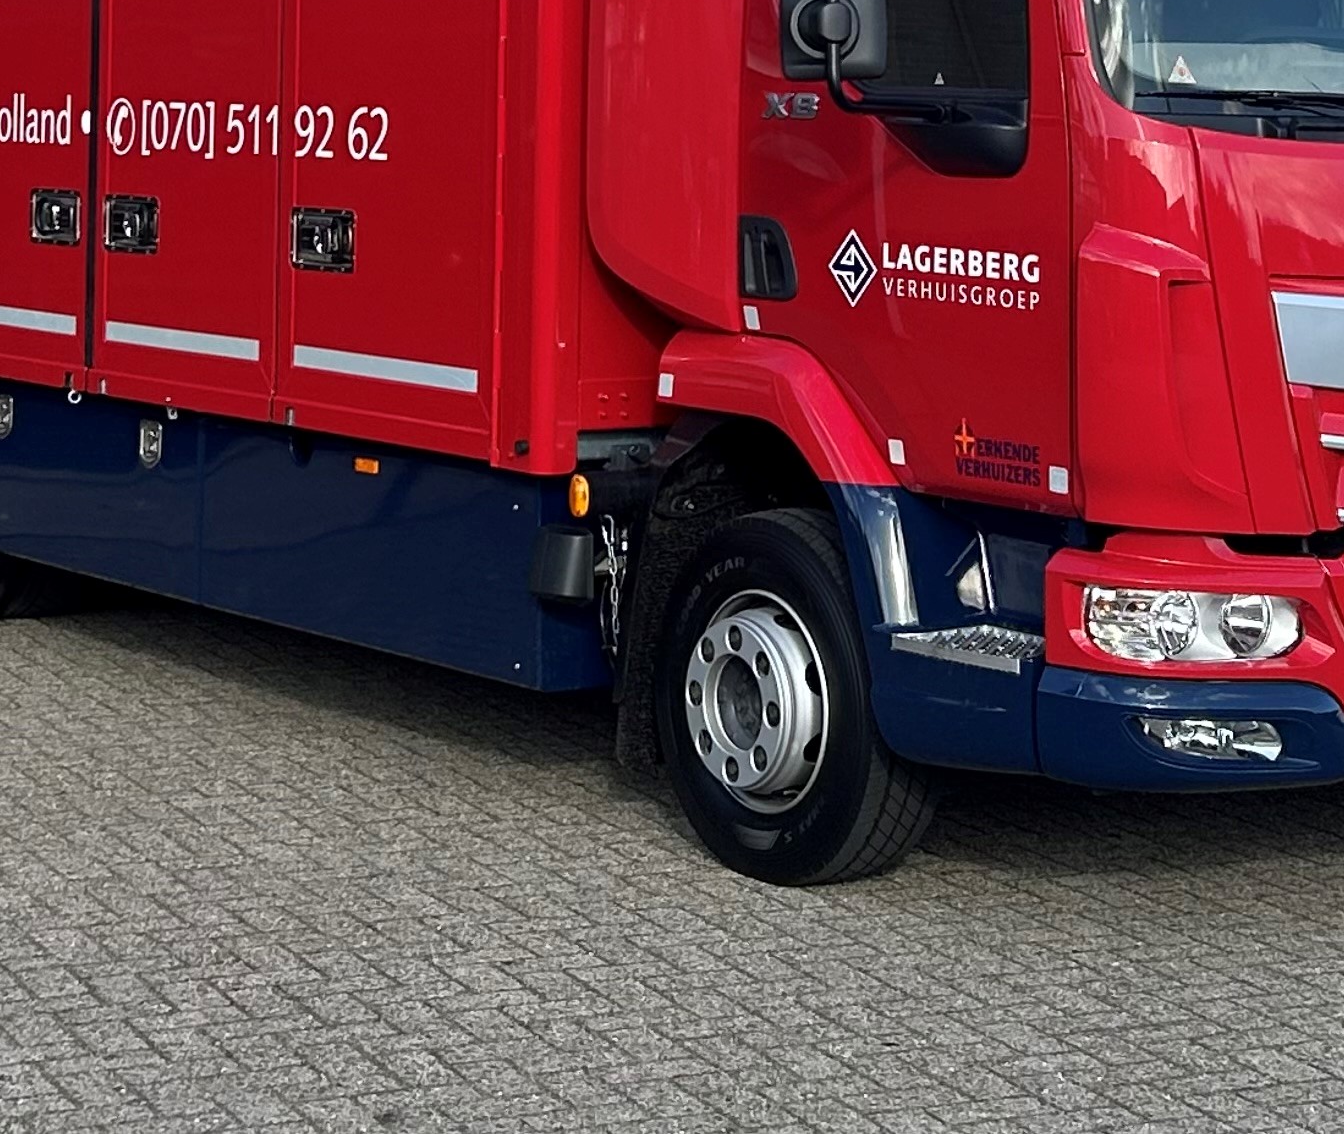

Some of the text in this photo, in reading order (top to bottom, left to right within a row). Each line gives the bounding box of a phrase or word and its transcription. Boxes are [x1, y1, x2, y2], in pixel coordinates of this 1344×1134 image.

[141, 99, 215, 159] [070]
[226, 103, 279, 155] 511
[294, 104, 334, 158] 92
[347, 106, 388, 161] 62
[882, 242, 1040, 283] LAGERBERG
[882, 277, 1040, 310] VERHUISGROEP
[976, 437, 1040, 465] ERKENDE
[956, 456, 1041, 487] VERHUIZERS
